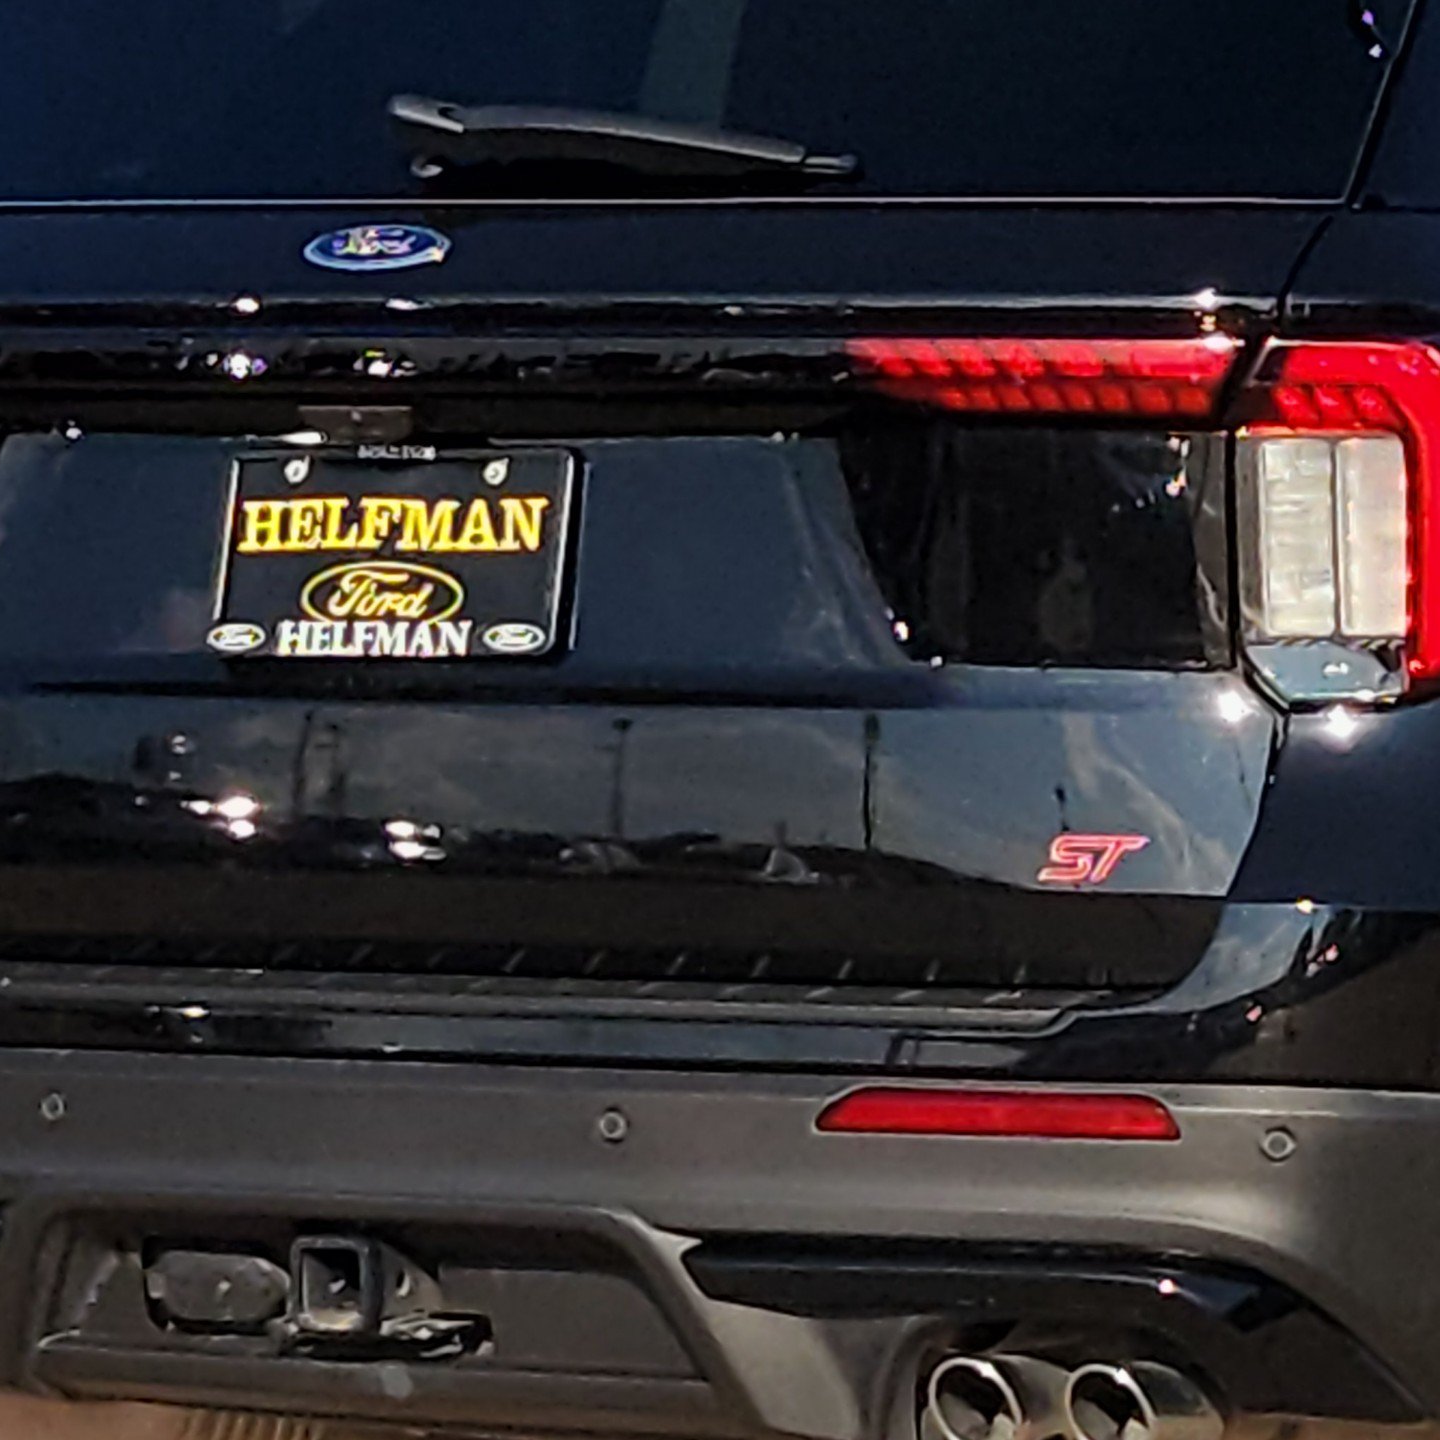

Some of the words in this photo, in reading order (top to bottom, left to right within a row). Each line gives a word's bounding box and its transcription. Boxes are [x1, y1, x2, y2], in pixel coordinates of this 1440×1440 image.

[236, 496, 551, 553] HELFMAN
[326, 569, 434, 618] Ford
[276, 619, 473, 658] HELFMAN
[1036, 834, 1152, 885] ST
